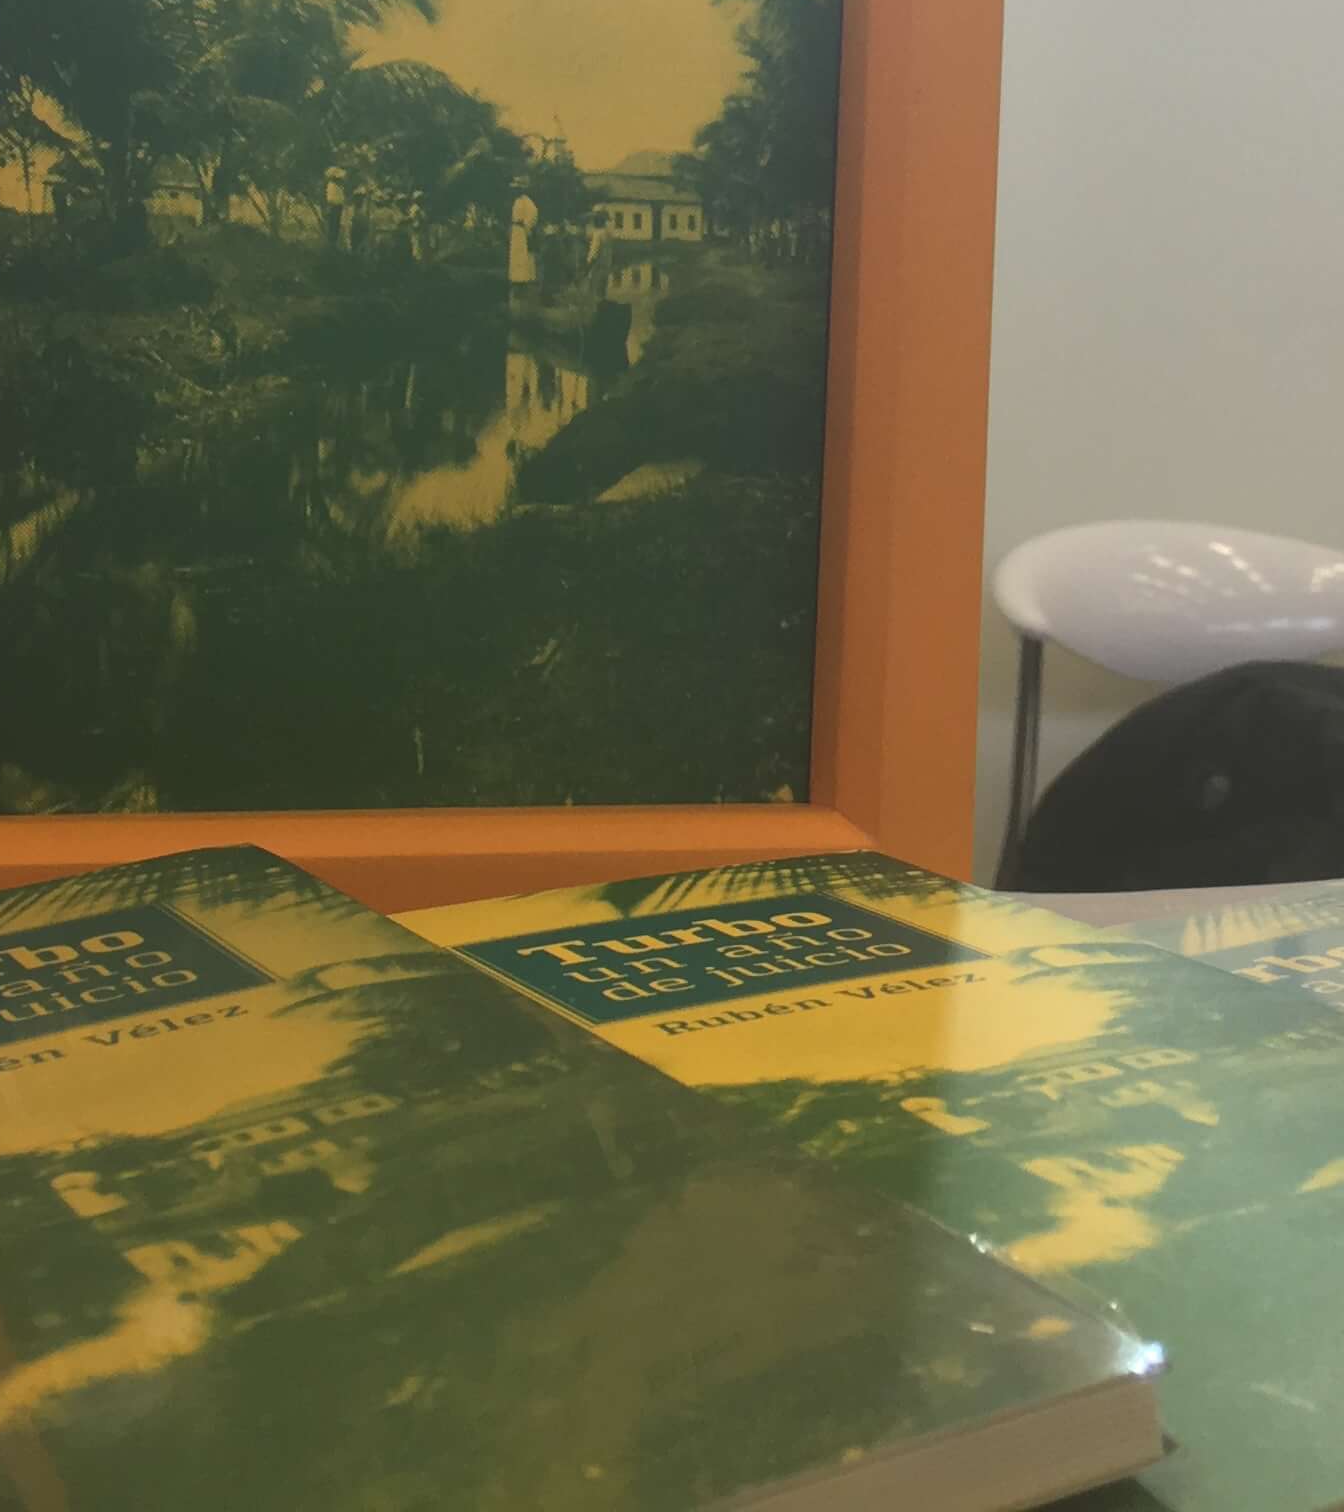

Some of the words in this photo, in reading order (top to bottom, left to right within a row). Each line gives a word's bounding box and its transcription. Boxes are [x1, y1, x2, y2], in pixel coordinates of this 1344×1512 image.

[516, 911, 834, 967] Turbo
[562, 953, 689, 985] un
[716, 926, 875, 961] año
[600, 975, 697, 1003] de
[705, 941, 914, 988] juicio
[81, 1004, 250, 1048] Vélez
[656, 995, 834, 1037] Rubén
[834, 970, 988, 1001] Vélez
